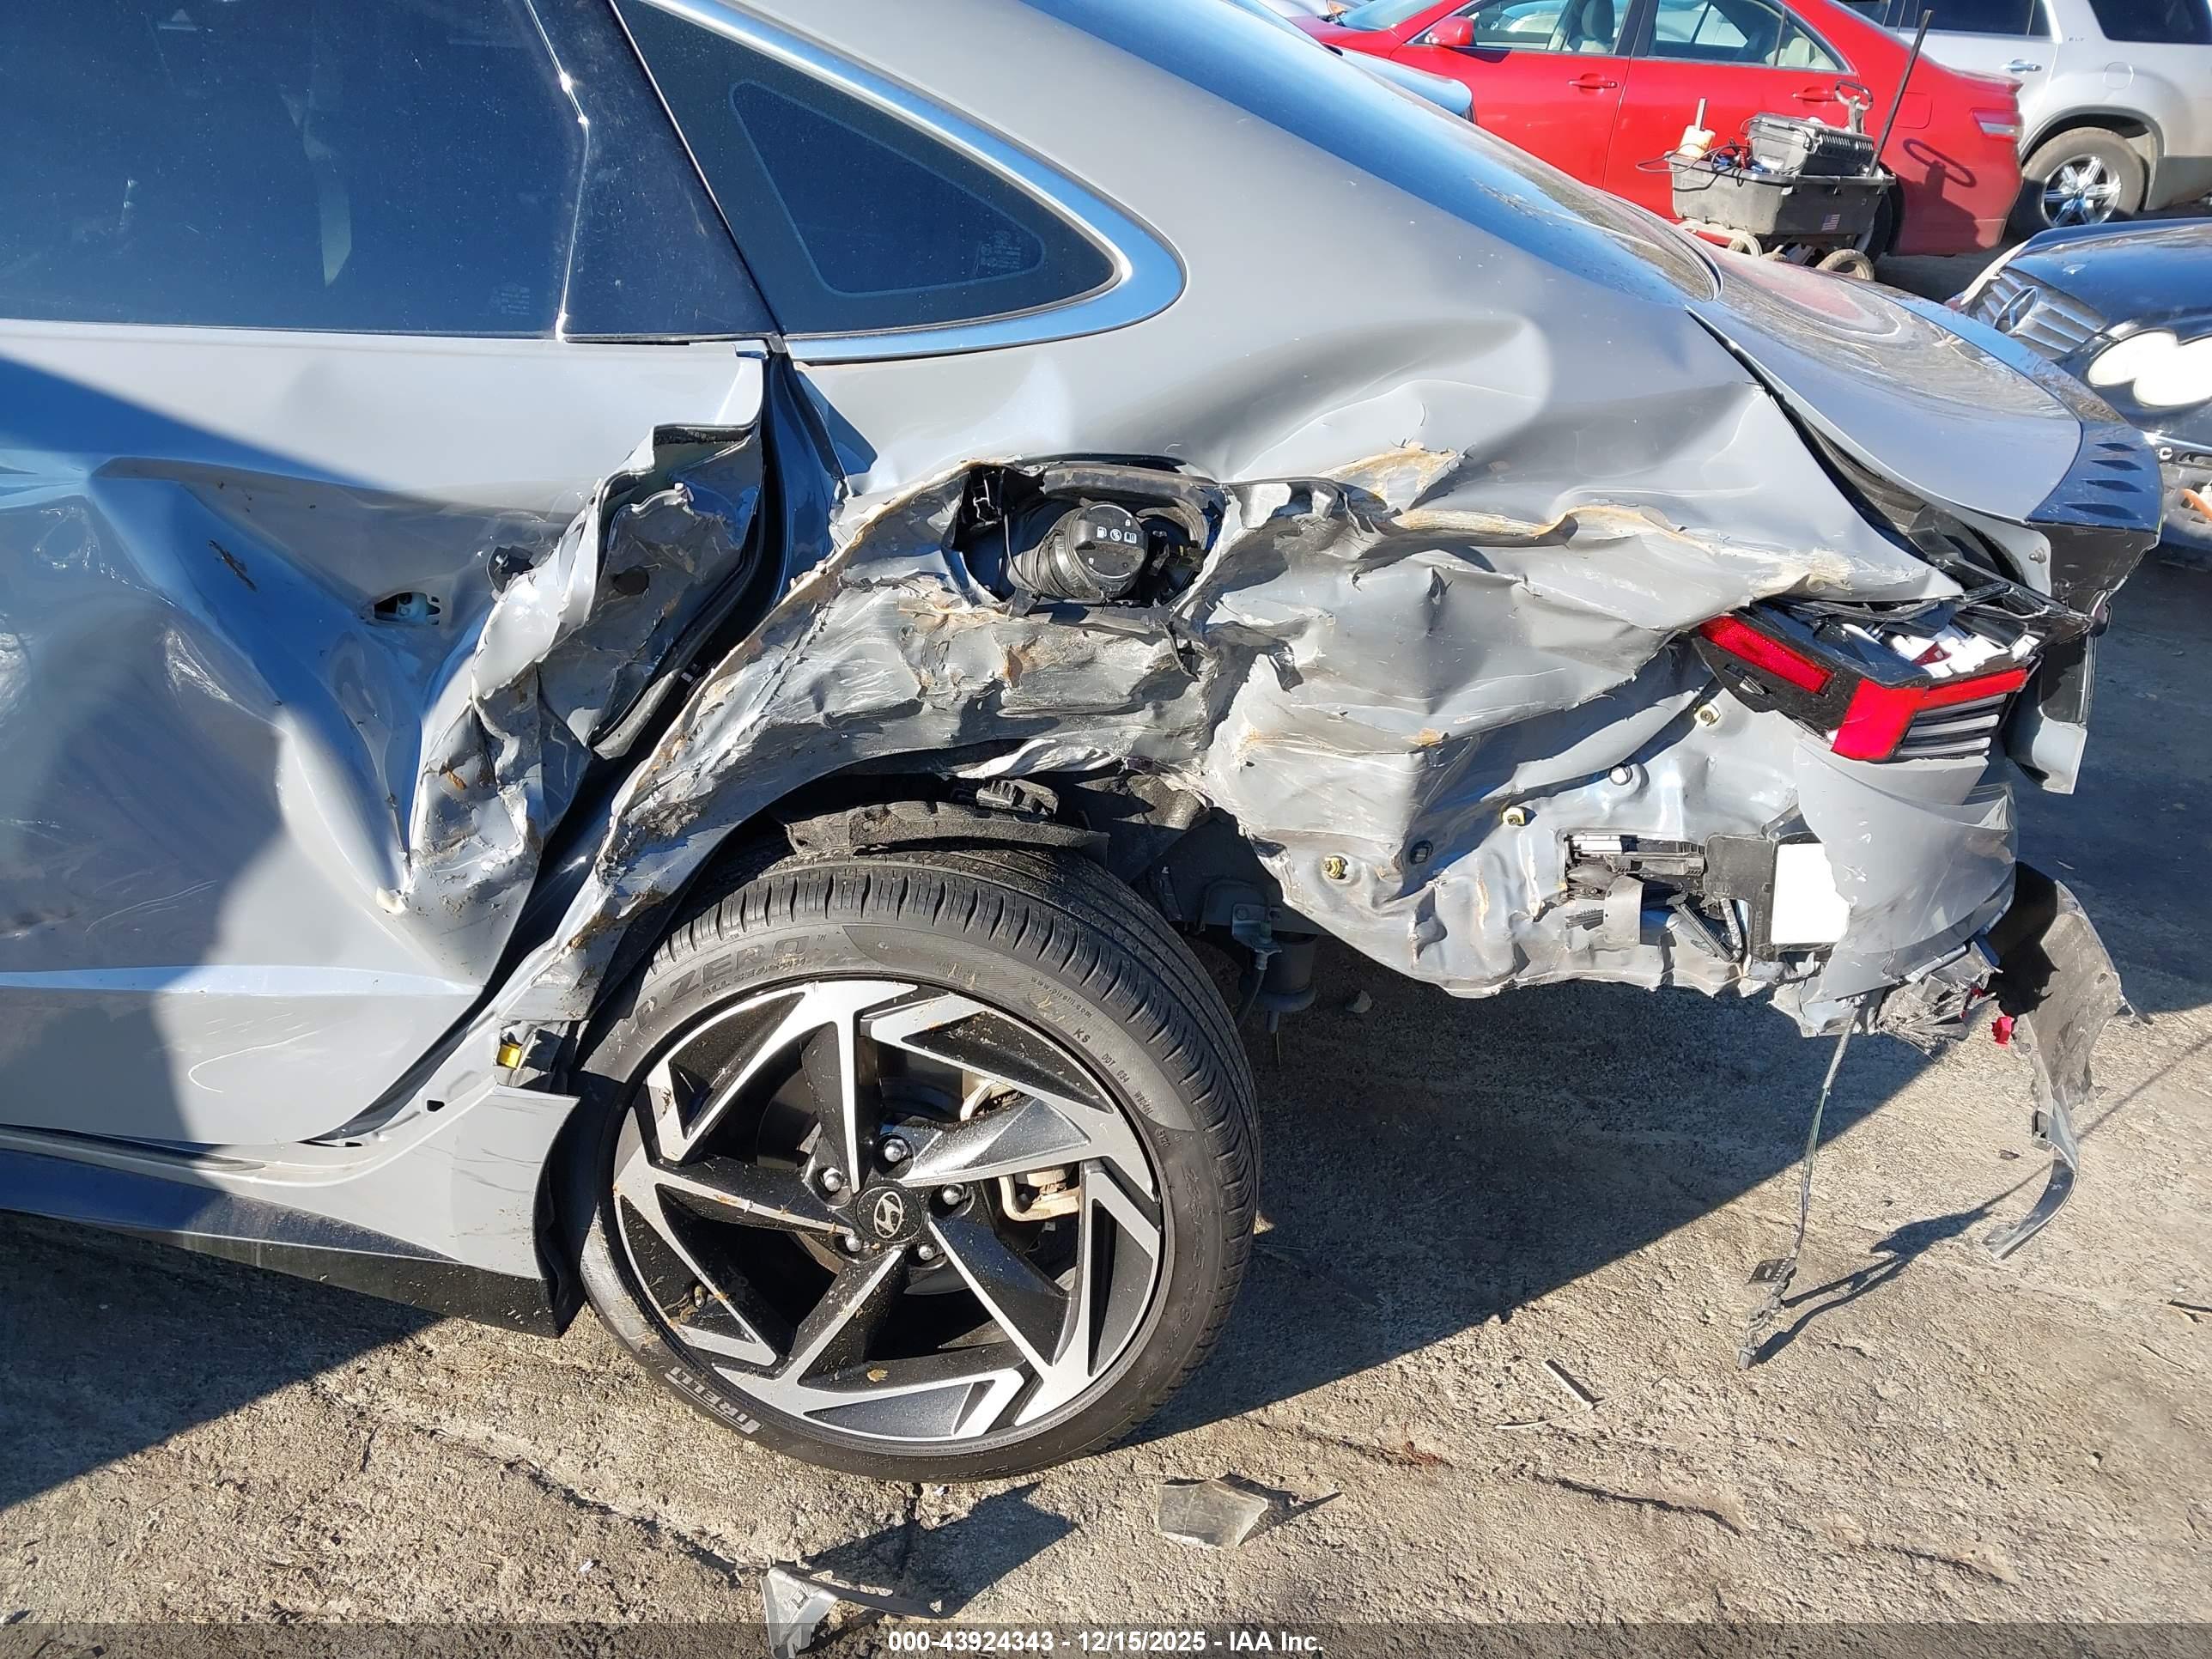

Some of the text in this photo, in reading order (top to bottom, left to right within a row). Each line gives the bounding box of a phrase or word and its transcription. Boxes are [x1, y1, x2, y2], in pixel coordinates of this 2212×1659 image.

[670, 935, 811, 1003] ZERO
[702, 979, 731, 999] ALL
[1030, 976, 1092, 1018] www.pirelli.com
[1073, 1028, 1091, 1043] KS
[1101, 1053, 1116, 1066] DOT
[665, 1366, 763, 1435] PIRELLI
